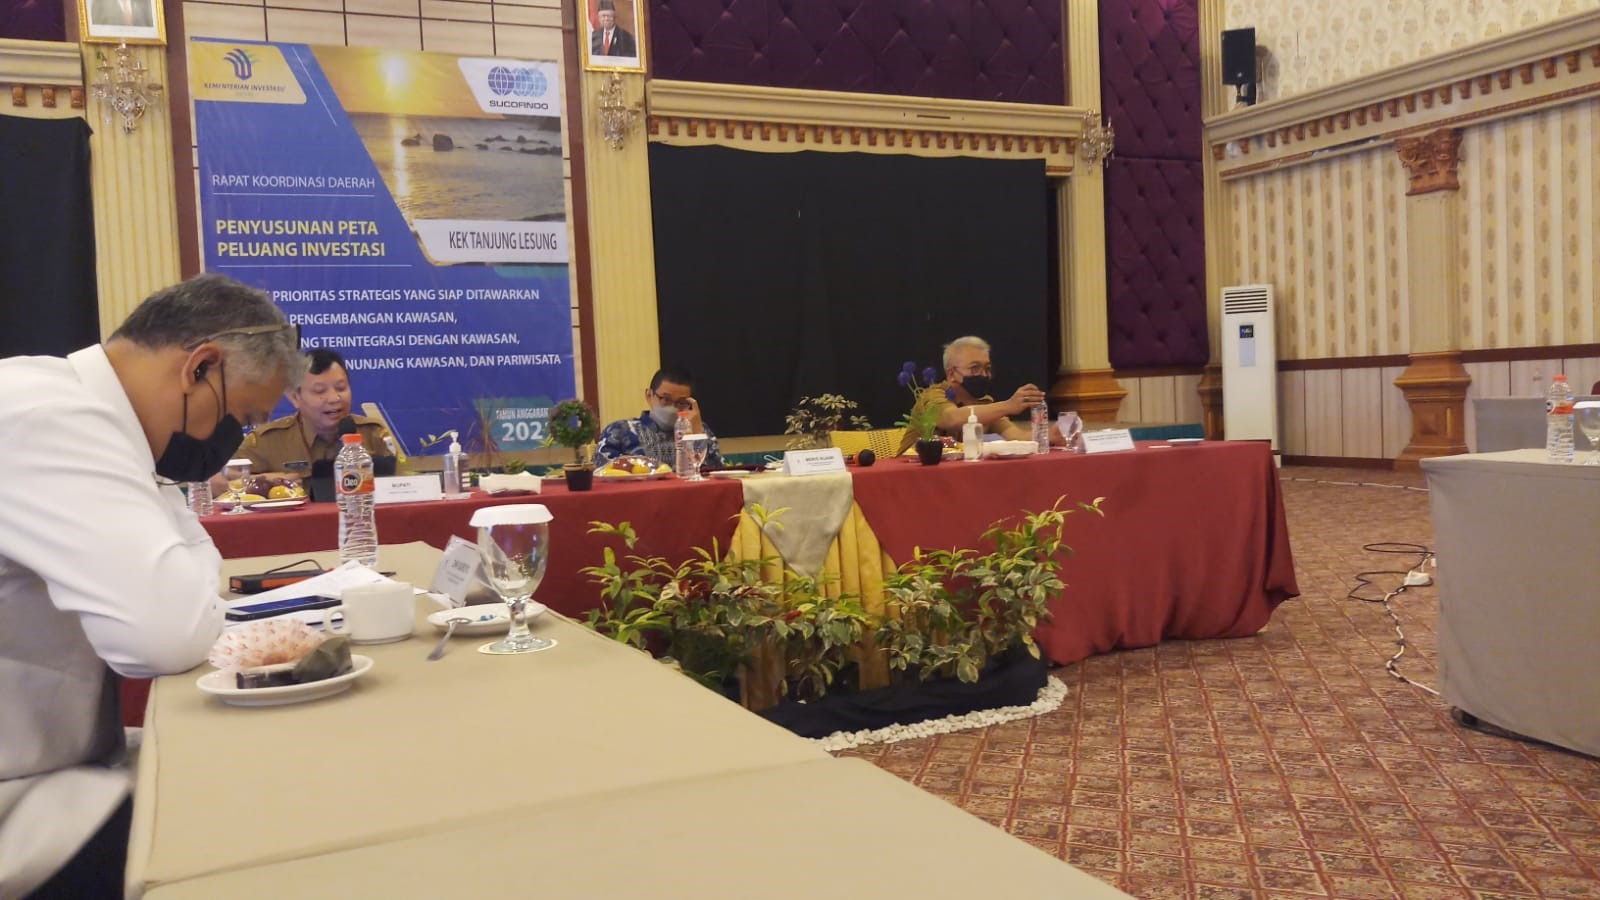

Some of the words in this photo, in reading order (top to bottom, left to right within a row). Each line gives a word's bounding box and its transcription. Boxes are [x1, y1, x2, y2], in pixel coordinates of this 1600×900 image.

[204, 82, 250, 91] KEMENTERIAN
[489, 100, 549, 110] SUCOFINDO
[212, 174, 250, 187] RAPAT
[252, 175, 326, 188] KOORDINASI
[328, 176, 376, 189] DAERAH
[216, 219, 334, 235] PENYUSUNAN
[338, 221, 379, 236] PETA
[449, 231, 469, 249] KEK
[469, 231, 517, 250] TANJUNG
[519, 232, 558, 250] LESUNG
[217, 242, 299, 258] PELUANG
[302, 242, 386, 257] INVESTASI
[272, 290, 336, 302] PRIORITAS
[338, 290, 401, 301] STRATEGIS
[403, 289, 436, 301] YANG
[438, 289, 464, 300] SIAP
[466, 289, 540, 300] DITAWARKAN
[289, 313, 394, 326] PENGEMBANGAN
[395, 312, 458, 325] KAWASAN,
[300, 337, 320, 349] NG
[321, 335, 406, 348] TERINTEGRASI
[408, 334, 459, 346] DENGAN
[460, 333, 521, 345] KAWASAN,
[344, 358, 404, 371] NUNJANG
[406, 356, 468, 369] KAWASAN,
[469, 356, 496, 367] DAN
[497, 354, 562, 366] PARIWISATA
